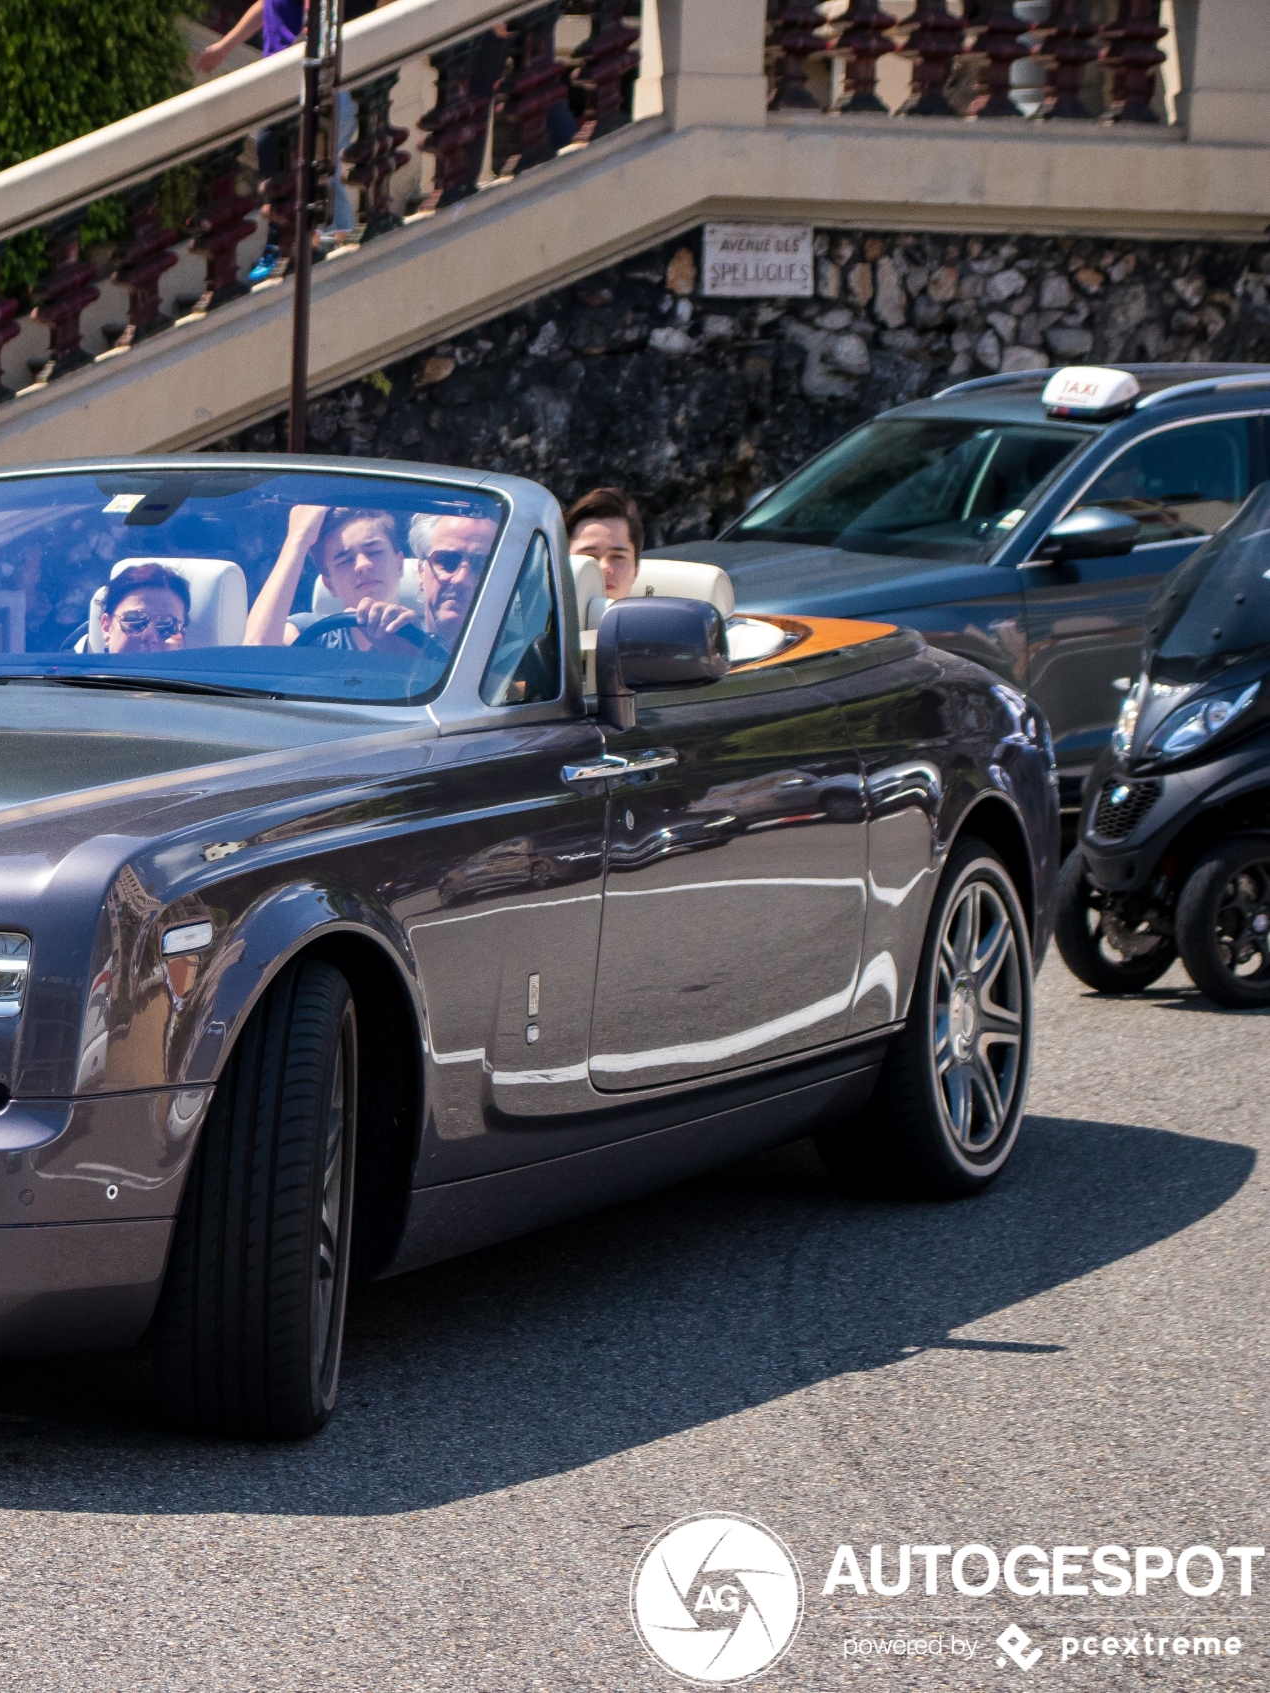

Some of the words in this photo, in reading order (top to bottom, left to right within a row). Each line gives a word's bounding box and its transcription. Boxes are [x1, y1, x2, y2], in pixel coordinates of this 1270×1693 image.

[720, 238, 770, 252] AVENUE
[774, 239, 799, 252] DES
[711, 262, 810, 282] SPELUGUES
[1062, 380, 1100, 396] TAXI
